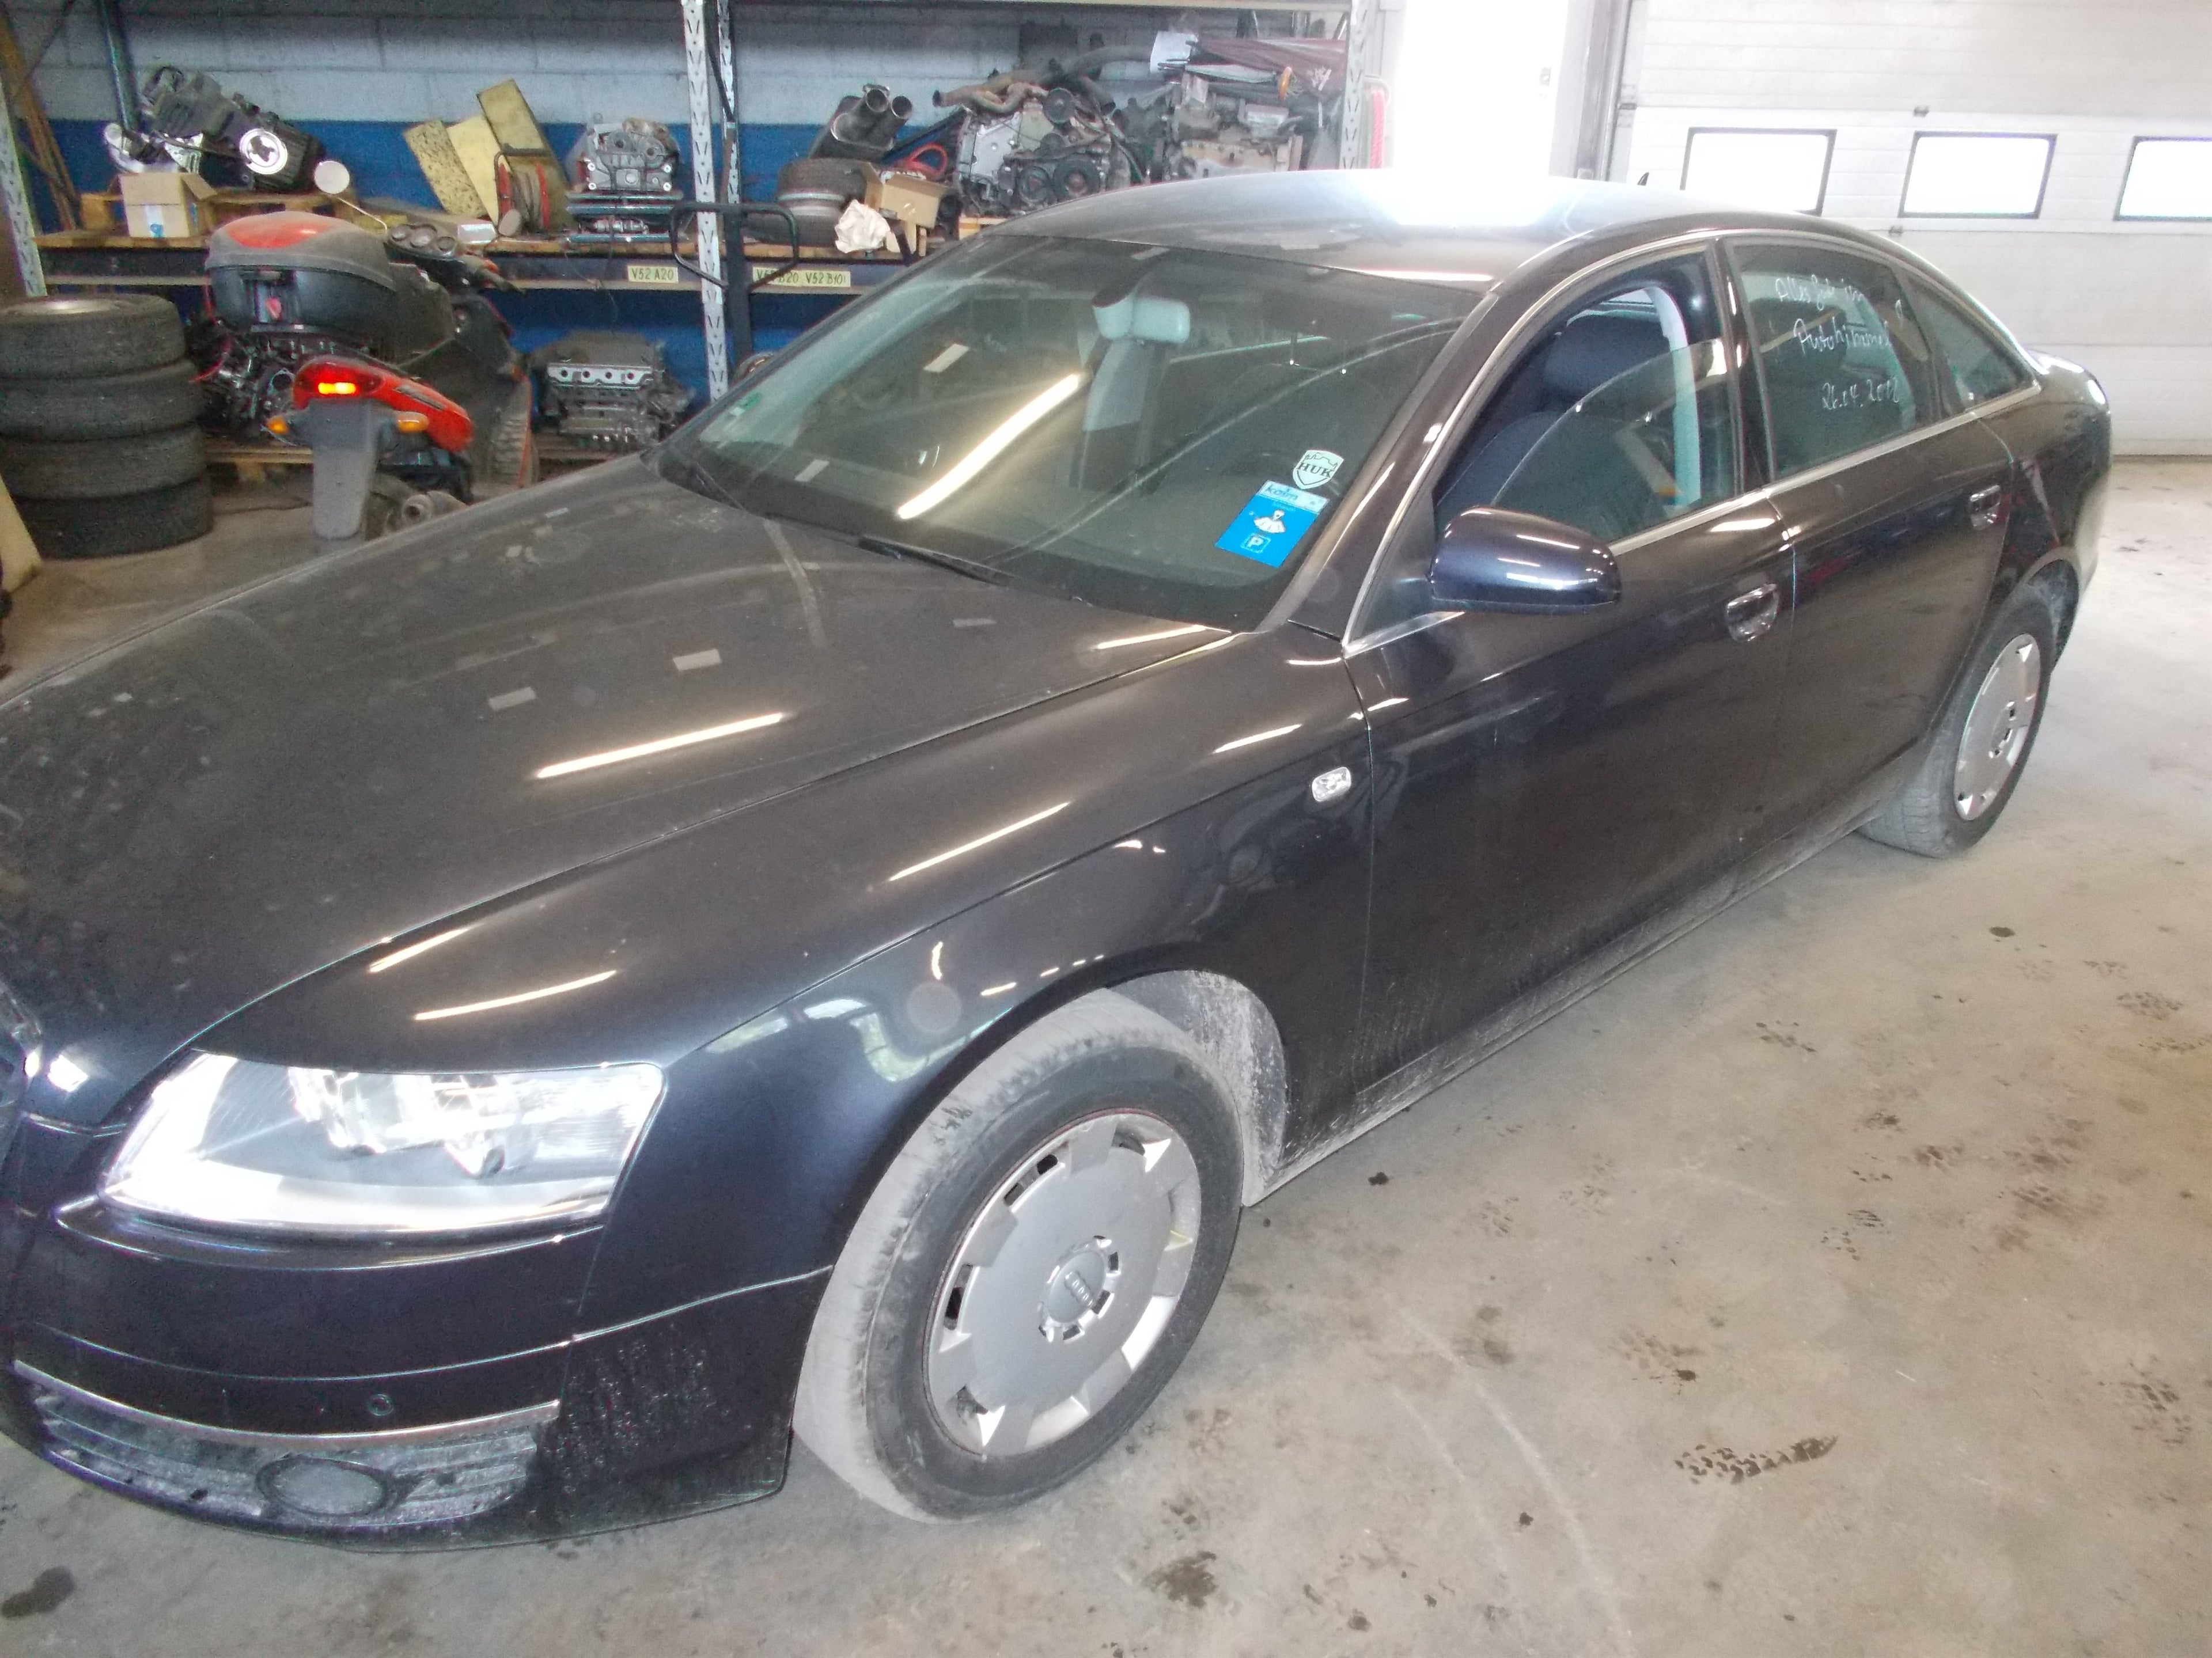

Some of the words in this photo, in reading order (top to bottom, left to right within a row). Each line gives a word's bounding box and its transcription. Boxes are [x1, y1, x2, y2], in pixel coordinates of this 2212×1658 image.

[631, 268, 651, 280] V52
[653, 268, 674, 280] A20
[805, 272, 824, 284] V52
[1296, 461, 1335, 478] HUK
[1247, 536, 1264, 547] P
